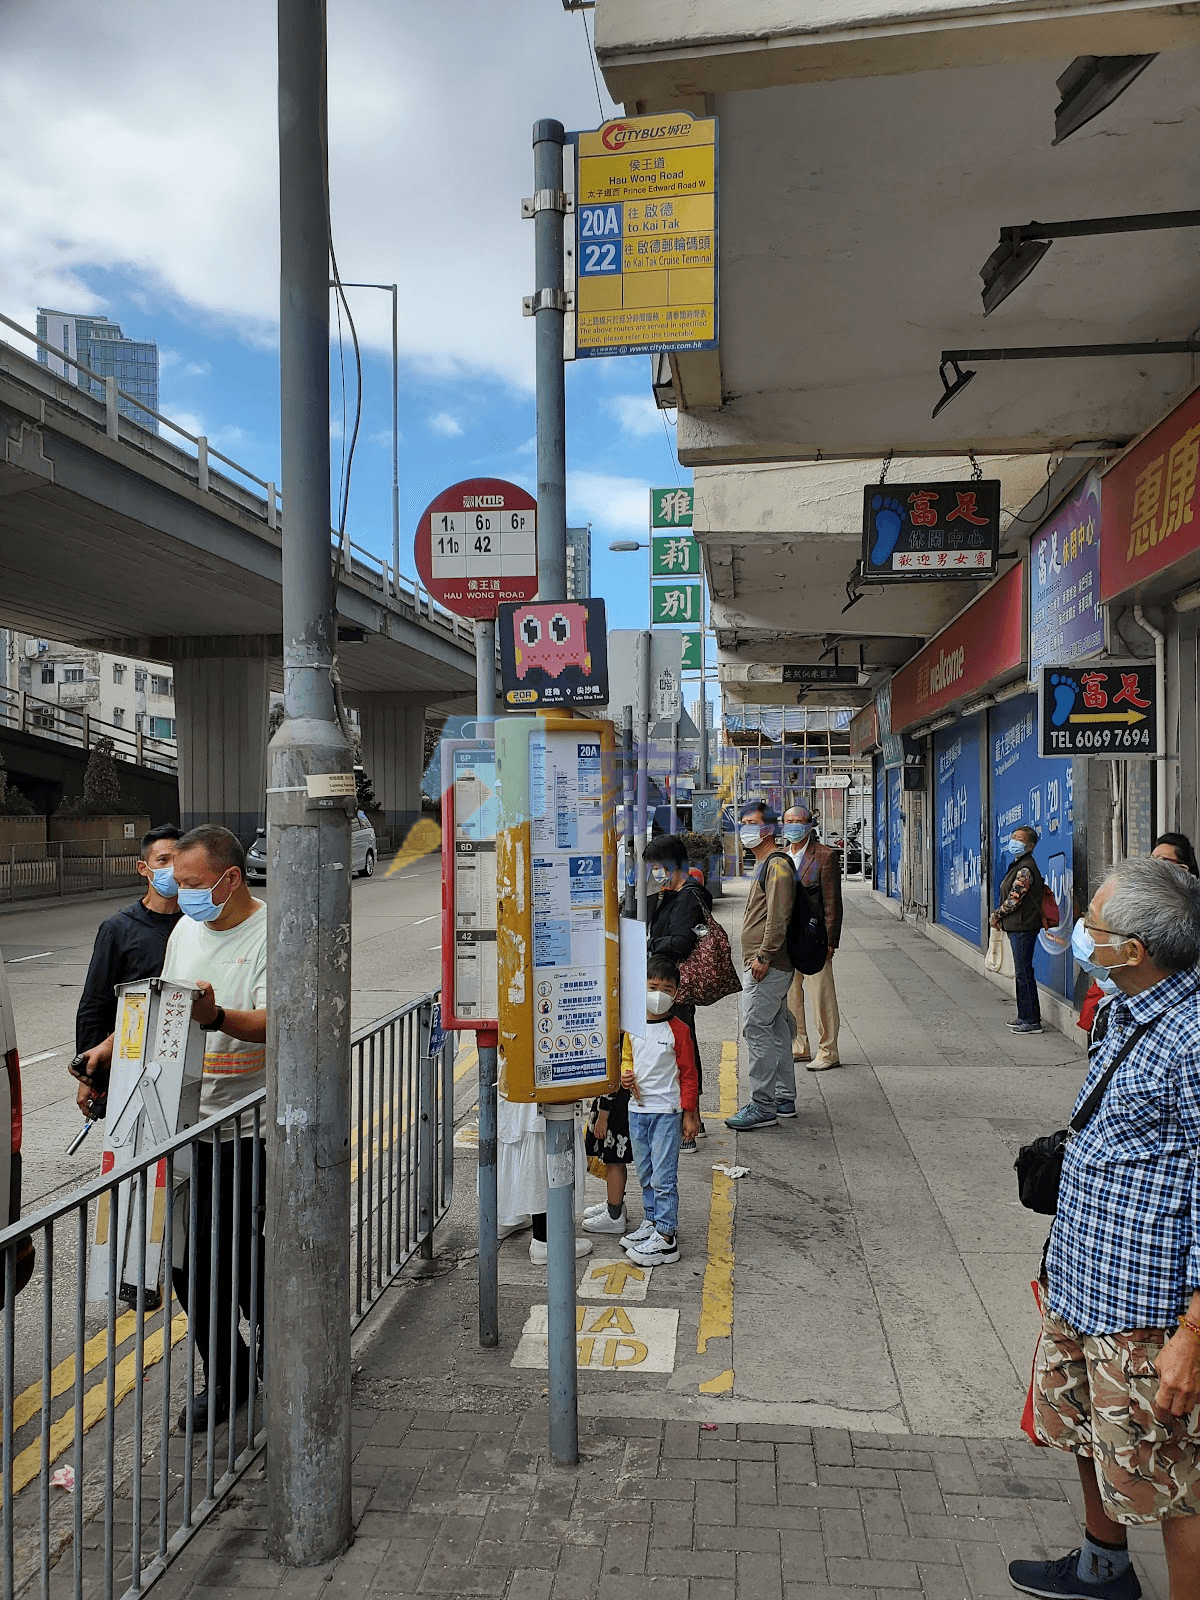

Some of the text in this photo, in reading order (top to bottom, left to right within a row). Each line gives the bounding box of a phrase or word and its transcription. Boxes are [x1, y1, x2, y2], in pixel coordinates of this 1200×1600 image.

[614, 126, 666, 143] CITYBUS
[667, 123, 692, 136] 城巴
[629, 157, 666, 172] 侯王道
[609, 170, 684, 185] Hau Wong Road
[587, 188, 620, 199] 太子道西
[623, 180, 706, 195] Prince Edward Road W
[628, 208, 639, 219] 往
[582, 207, 619, 236] 20A
[628, 218, 680, 232] to Kai Tak
[624, 244, 634, 255] 往
[584, 244, 616, 272] 22
[624, 252, 712, 269] to Kai Tak Cruise Terminal
[579, 327, 591, 335] The
[593, 326, 612, 334] above
[647, 322, 669, 330] served
[678, 320, 708, 329] specified
[603, 334, 623, 343] please
[663, 330, 697, 338] timetable.
[630, 341, 702, 353] www.citybus.com.hk
[474, 495, 504, 508] KMB
[907, 491, 990, 527] 富足
[441, 515, 454, 532] 1A
[475, 514, 490, 531] 6D
[511, 513, 525, 530] 6P
[437, 537, 459, 554] 11D
[474, 536, 491, 553] 42
[898, 551, 987, 568] 歡迎男女賓
[468, 580, 500, 590] 侯王道
[443, 591, 525, 600] HAU WONG ROAD
[545, 687, 561, 696] 旺角
[576, 685, 600, 694] 尖沙咀
[1080, 672, 1152, 708] 富足
[1050, 728, 1150, 749] TEL 6069 7694
[460, 754, 471, 762] 6P
[580, 746, 598, 757] 20A
[577, 860, 594, 874] 22
[461, 932, 473, 941] 42
